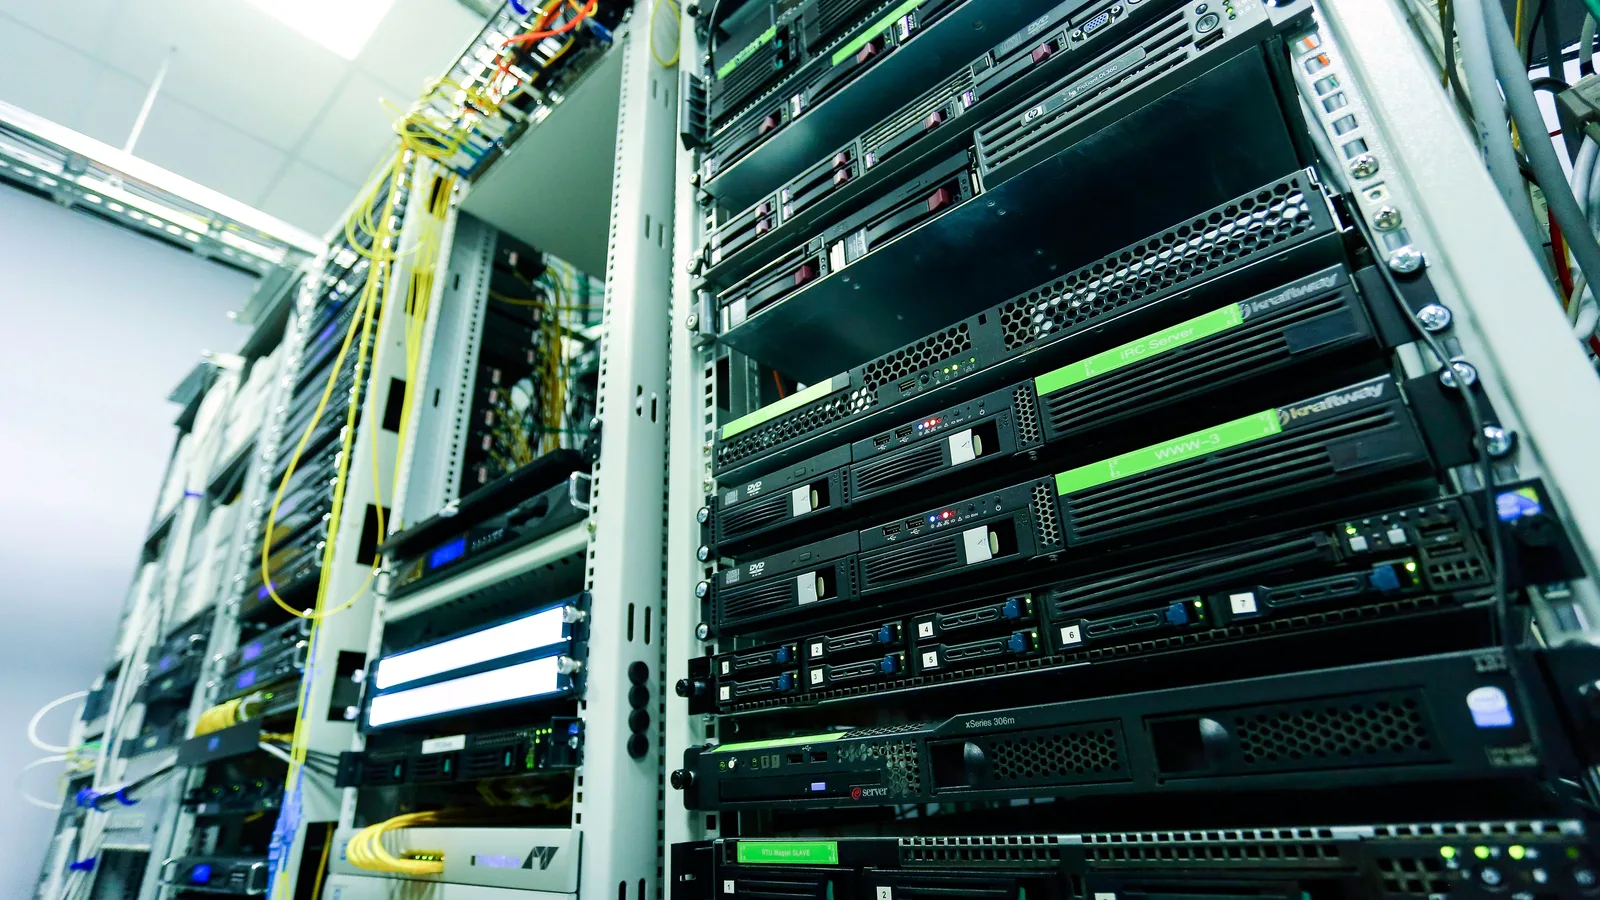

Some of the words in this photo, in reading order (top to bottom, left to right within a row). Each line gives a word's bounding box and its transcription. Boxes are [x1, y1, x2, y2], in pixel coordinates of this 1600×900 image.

[1027, 14, 1049, 32] DVD
[1252, 273, 1338, 312] kraftway
[1120, 344, 1146, 360] IRC
[1148, 327, 1195, 350] Server
[1289, 382, 1384, 420] kraftway
[747, 481, 762, 491] DVD
[749, 561, 765, 571] DVD
[965, 717, 992, 729] xSeries
[993, 716, 1015, 726] 306m
[792, 849, 811, 857] SLAVE
